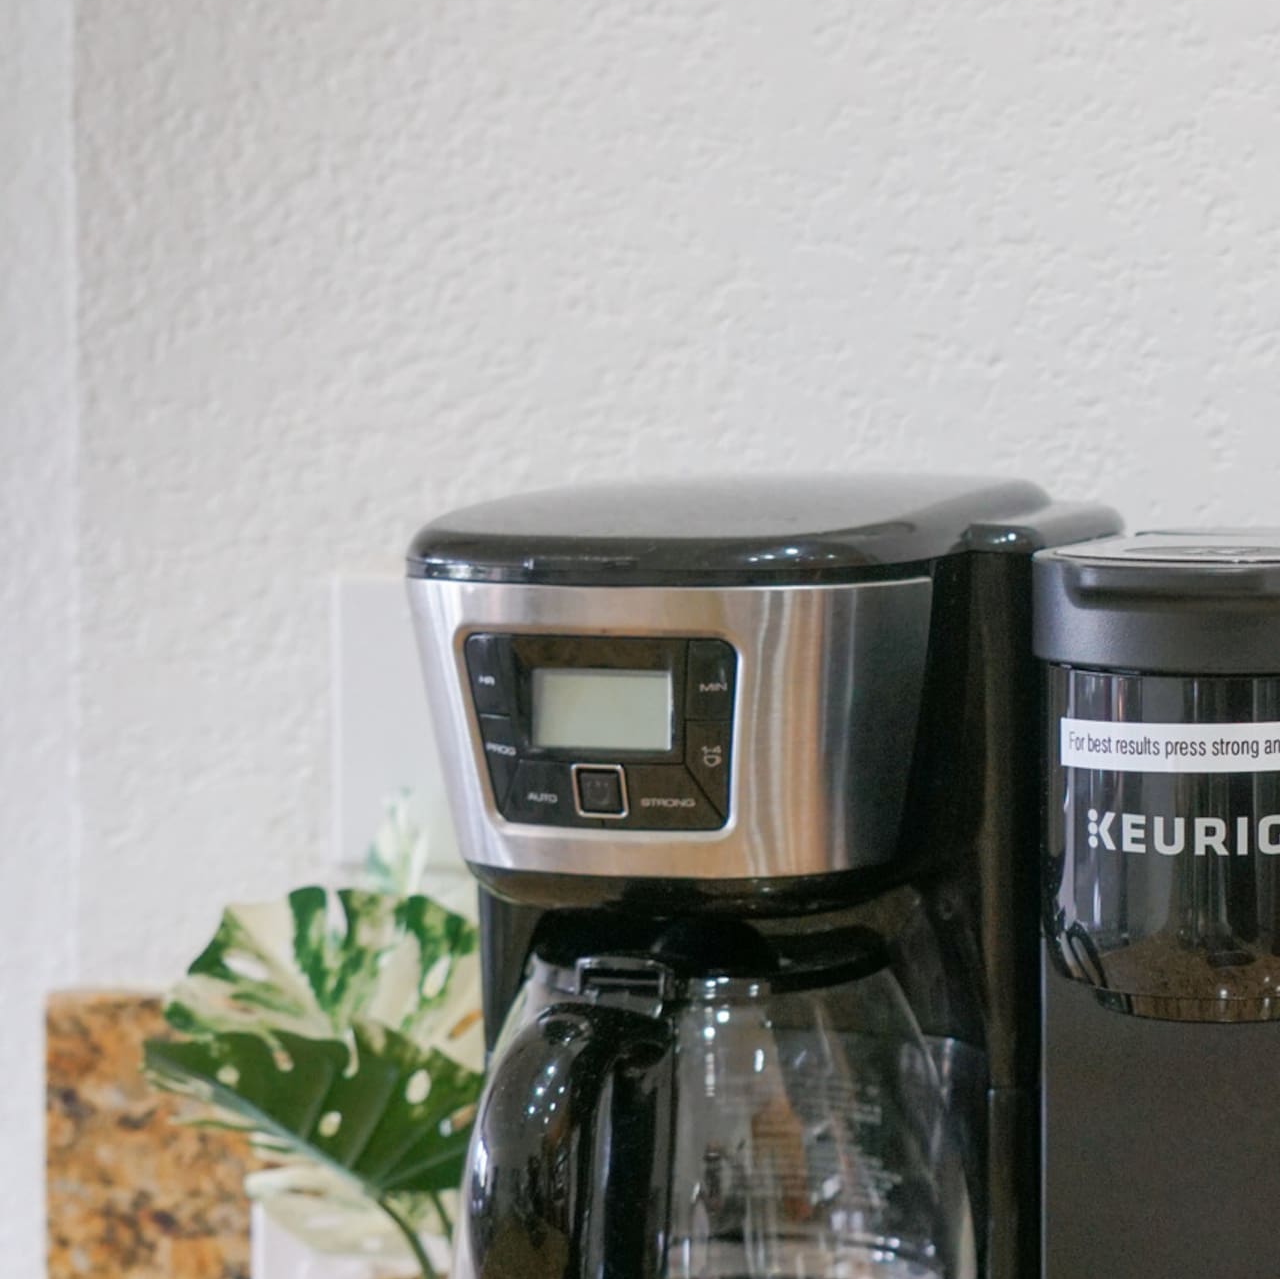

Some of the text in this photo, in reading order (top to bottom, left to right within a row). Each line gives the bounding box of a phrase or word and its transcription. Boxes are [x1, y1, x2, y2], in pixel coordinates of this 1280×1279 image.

[699, 682, 728, 692] MIN
[485, 742, 517, 757] PROG
[1069, 731, 1085, 752] For
[1087, 733, 1112, 754] best
[1115, 736, 1160, 756] results
[1165, 739, 1207, 759] press
[1211, 738, 1260, 759] strong
[527, 792, 558, 804] AUTO
[640, 797, 696, 808] STRONG
